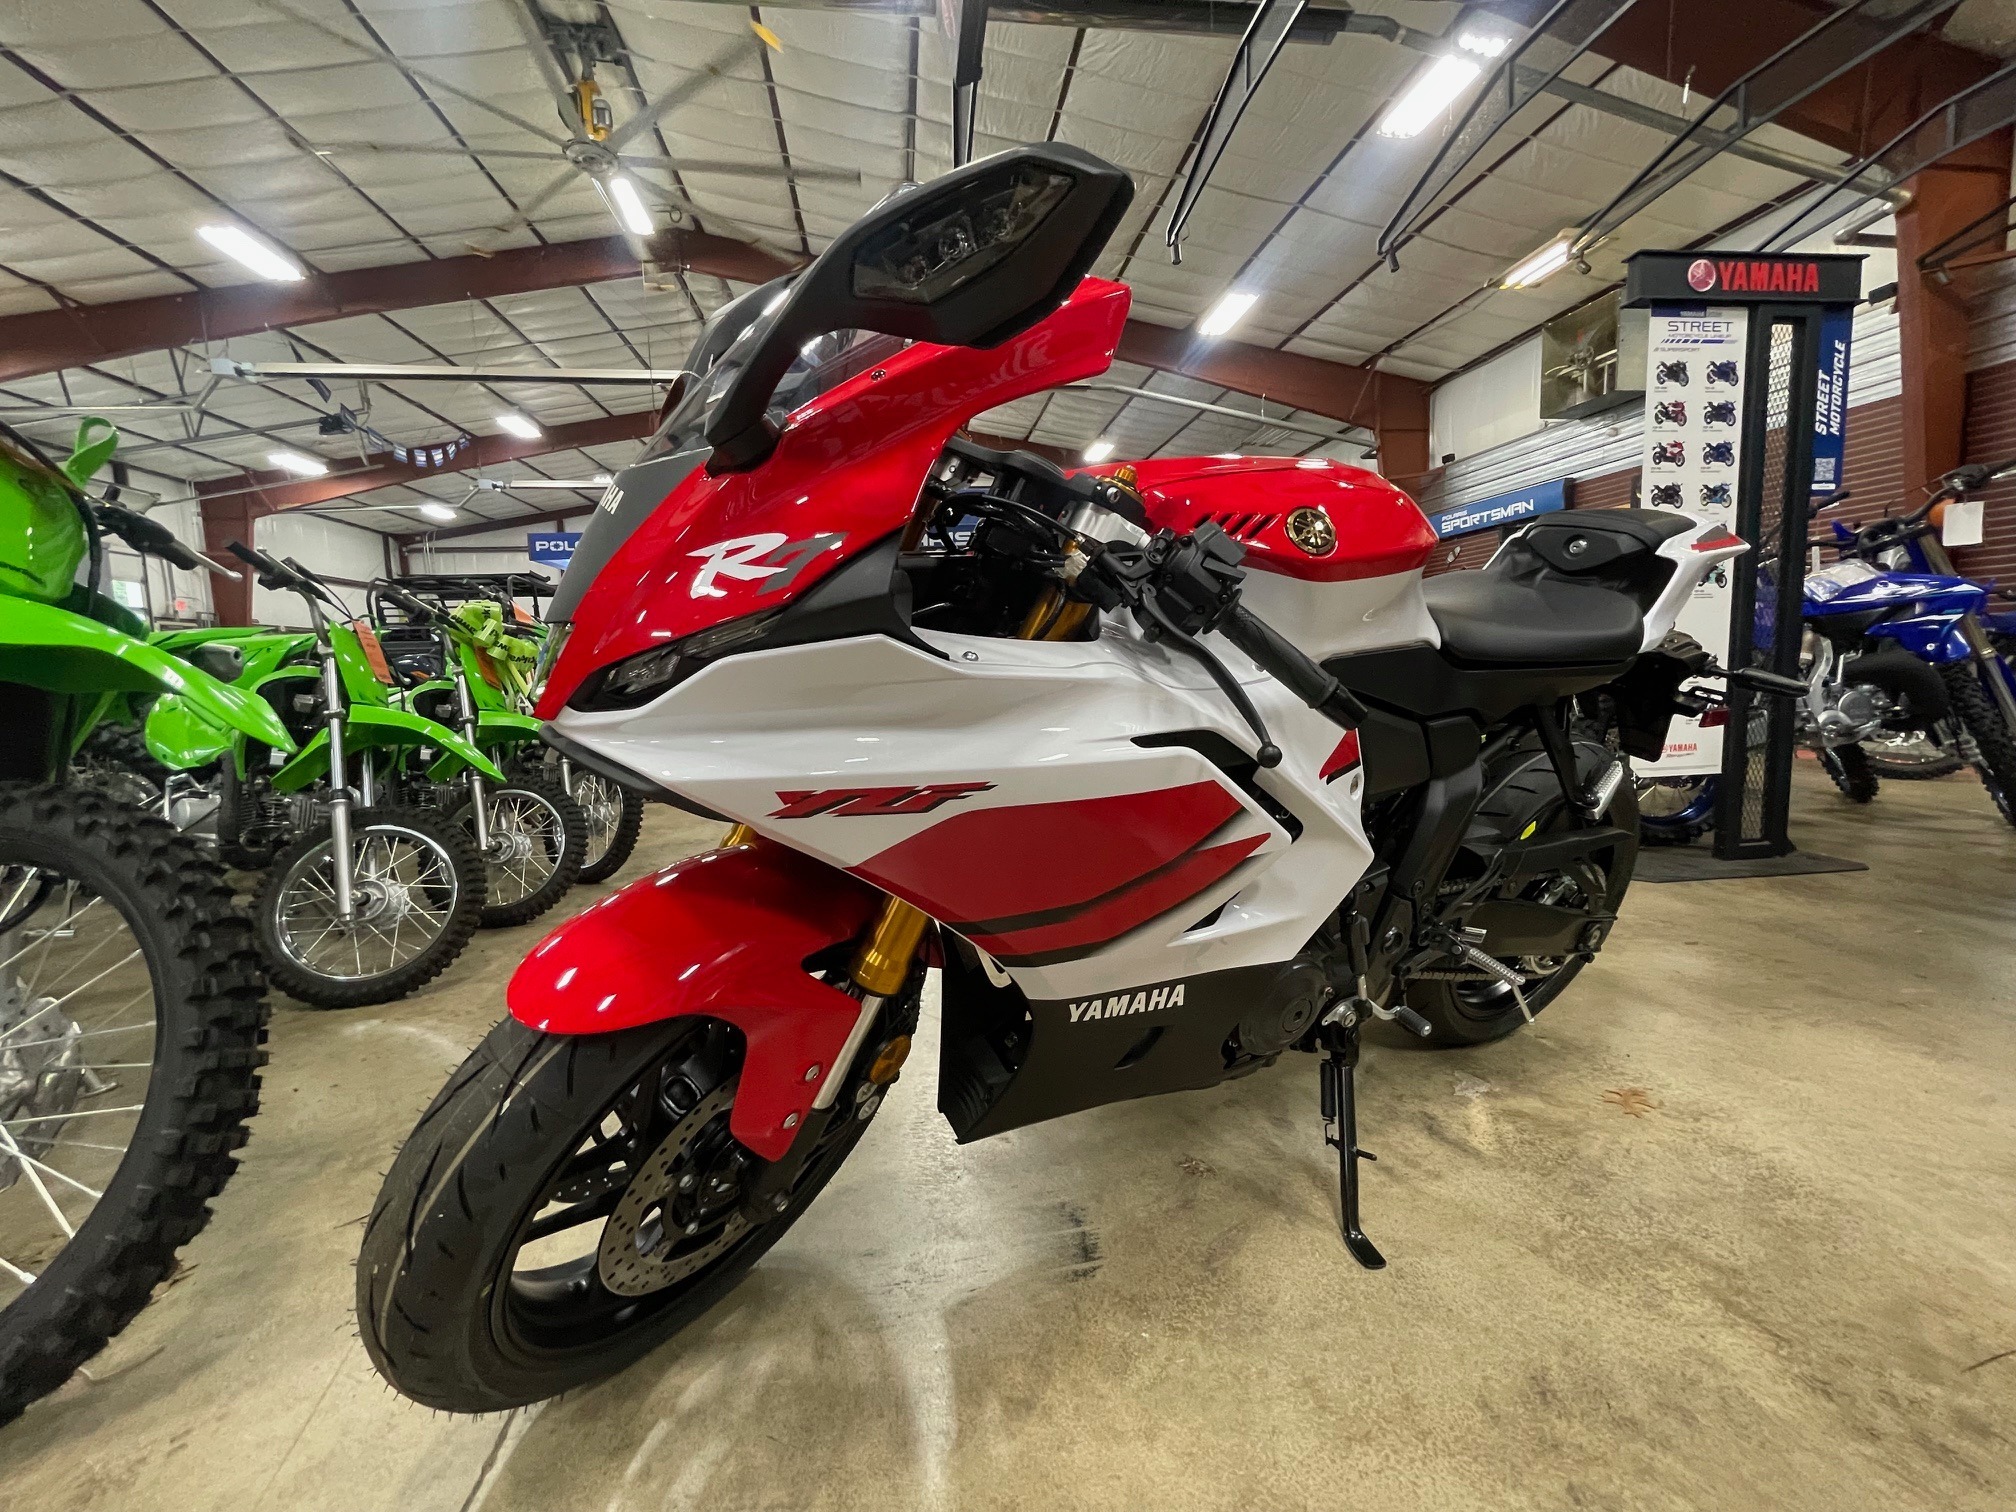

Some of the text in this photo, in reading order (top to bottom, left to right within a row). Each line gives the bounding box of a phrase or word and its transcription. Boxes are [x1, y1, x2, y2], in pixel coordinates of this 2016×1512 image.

[1718, 261, 1819, 292] YAMAHA
[1667, 321, 1733, 332] STREET
[1814, 369, 1832, 436] STREET
[1829, 339, 1846, 436] MOTORCYCLE
[1441, 509, 1468, 522] POLARIS
[1441, 499, 1534, 533] SPORTSMAN
[535, 541, 578, 552] POL
[686, 532, 850, 599] R7
[1668, 742, 1698, 753] YAMAHA
[765, 781, 998, 820] YZF
[1069, 984, 1185, 1023] YAMAHA
